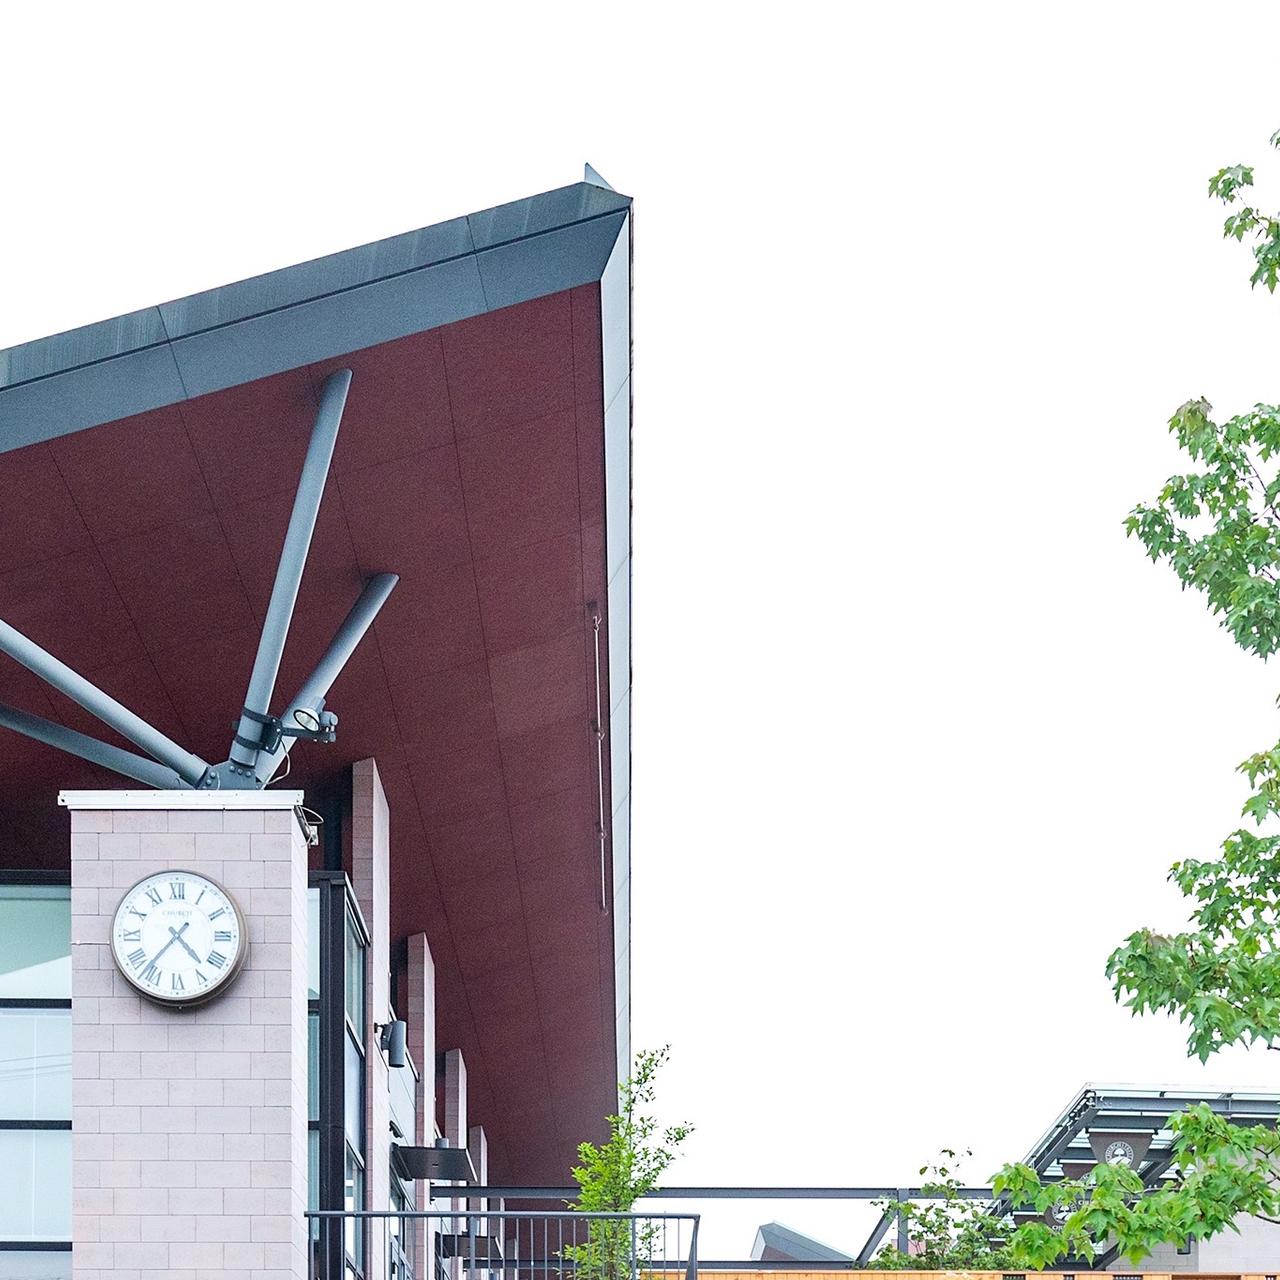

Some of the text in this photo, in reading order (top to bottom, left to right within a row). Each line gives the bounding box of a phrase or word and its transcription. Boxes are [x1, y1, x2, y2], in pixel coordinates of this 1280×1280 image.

[145, 887, 164, 907] XI
[169, 883, 185, 900] XII
[195, 889, 205, 905] I
[129, 906, 147, 921] X
[208, 907, 226, 921] II
[123, 929, 140, 941] IX
[214, 930, 231, 941] III
[171, 973, 185, 990] VI
[195, 968, 208, 986] V
